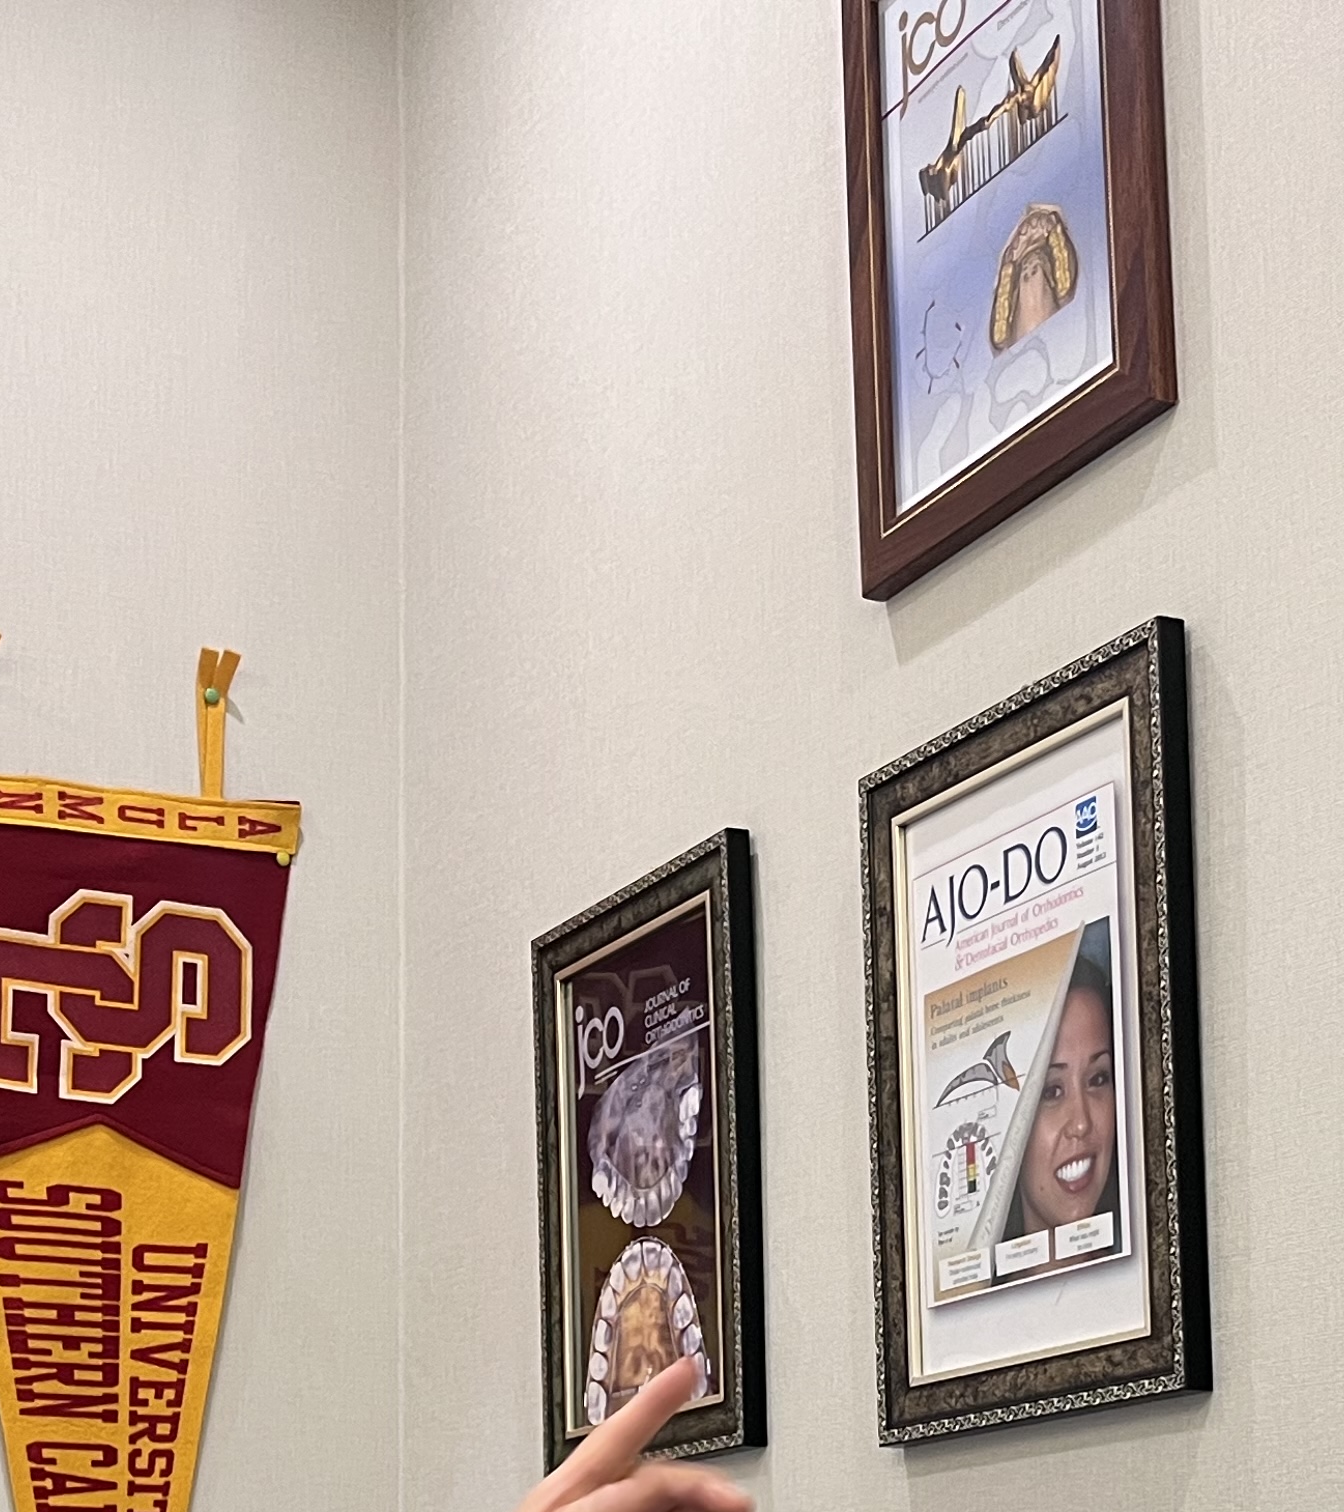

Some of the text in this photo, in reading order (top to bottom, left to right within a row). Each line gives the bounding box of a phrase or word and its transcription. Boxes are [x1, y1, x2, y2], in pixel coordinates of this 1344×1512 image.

[921, 826, 1068, 948] AJO-DO
[955, 886, 1084, 951] American Journal of Orthodontics
[965, 937, 1008, 965] Dentofacial
[1010, 917, 1059, 946] Orthopedics
[644, 977, 691, 1013] JOURNAL OF
[644, 1003, 677, 1028] CLINICAL
[930, 978, 1008, 1020] Palatal implants
[575, 1006, 624, 1100] jco
